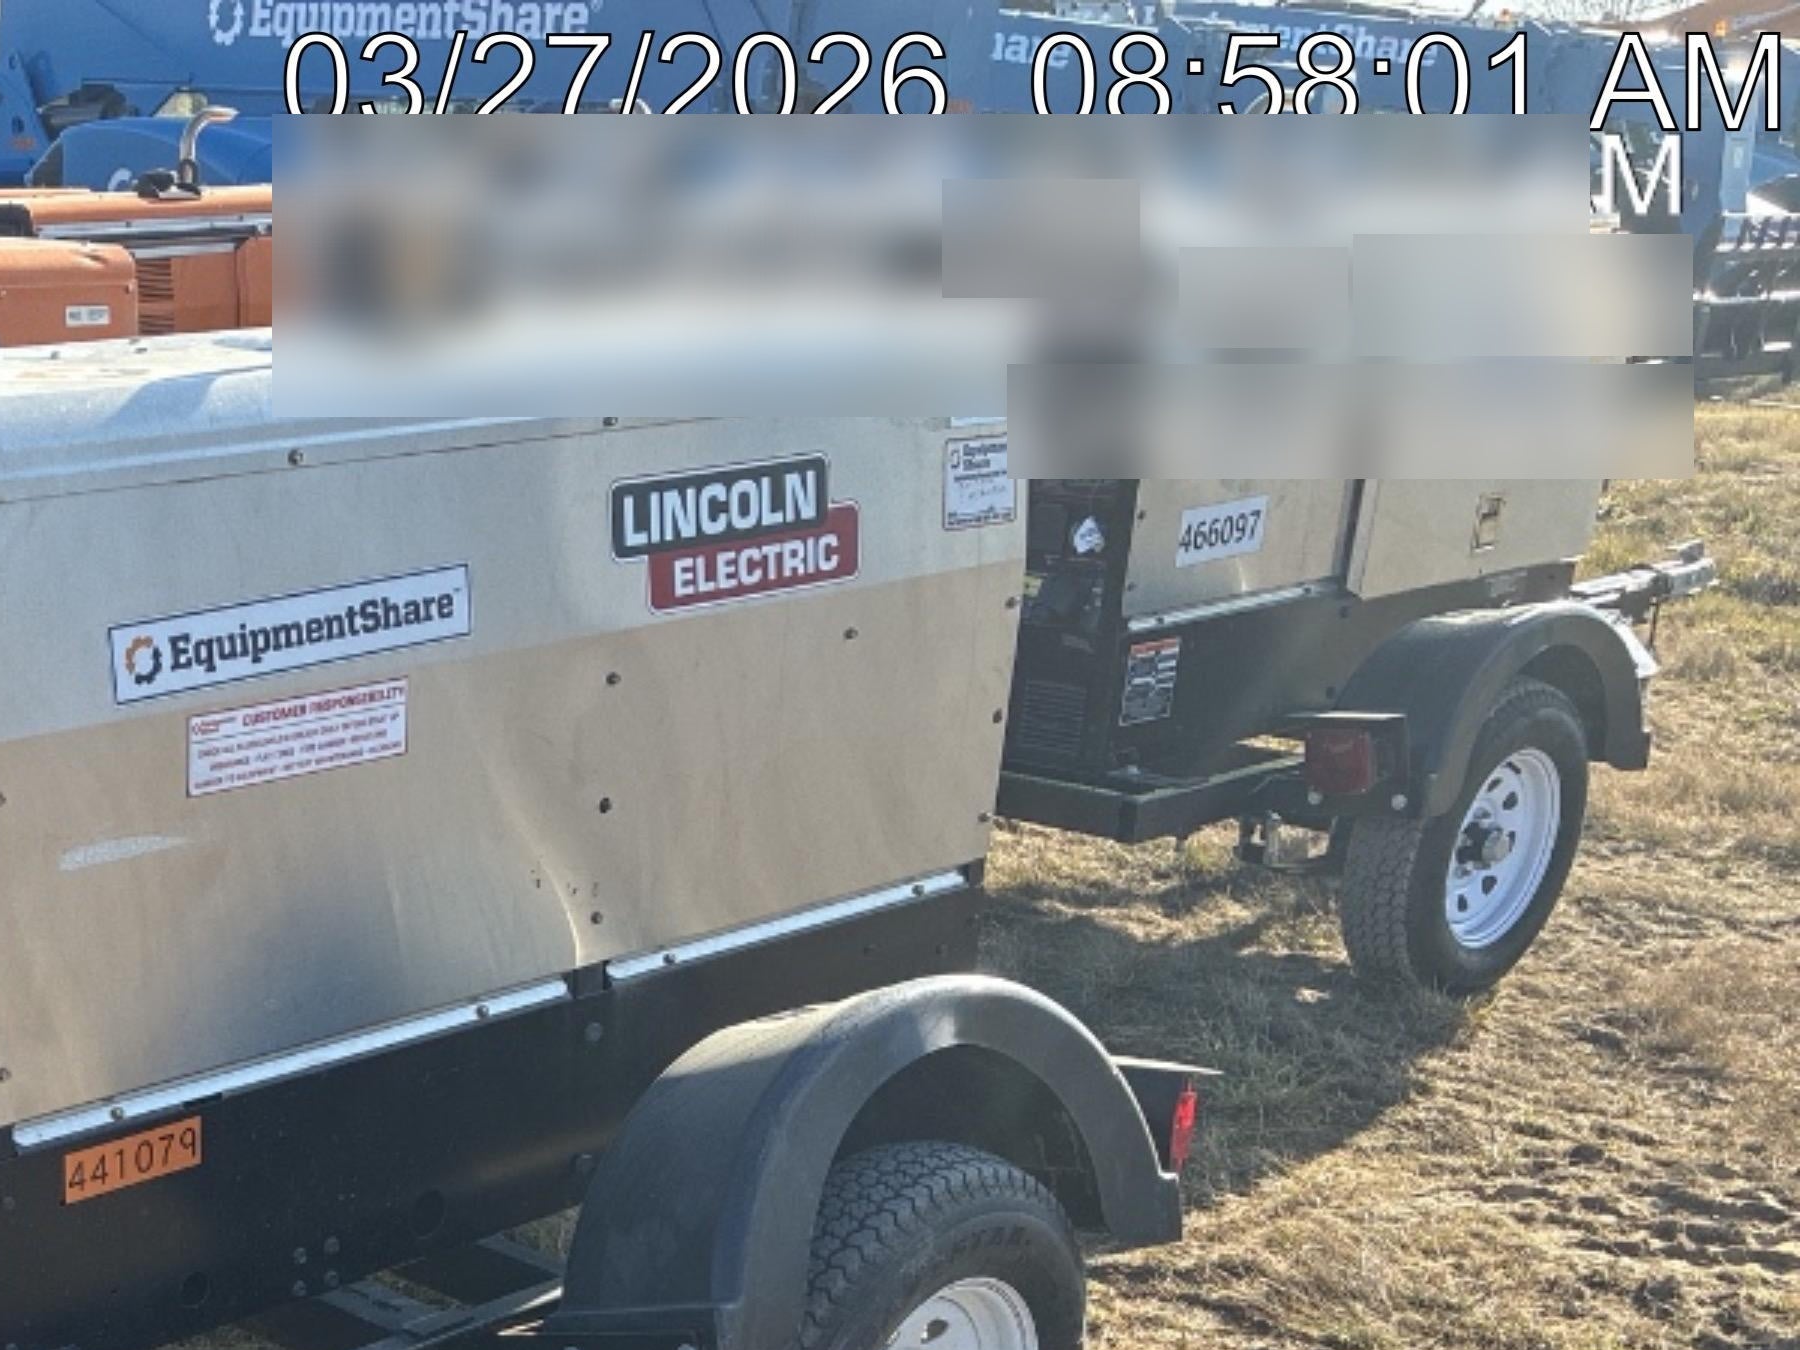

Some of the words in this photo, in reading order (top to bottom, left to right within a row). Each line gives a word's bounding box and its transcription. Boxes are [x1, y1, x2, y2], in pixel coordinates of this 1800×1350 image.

[623, 470, 817, 547] LINCOLN
[1179, 510, 1261, 552] 466097
[674, 534, 839, 597] ELECTRIC
[168, 592, 454, 672] EquipmentShare
[68, 1127, 196, 1191] 441079
